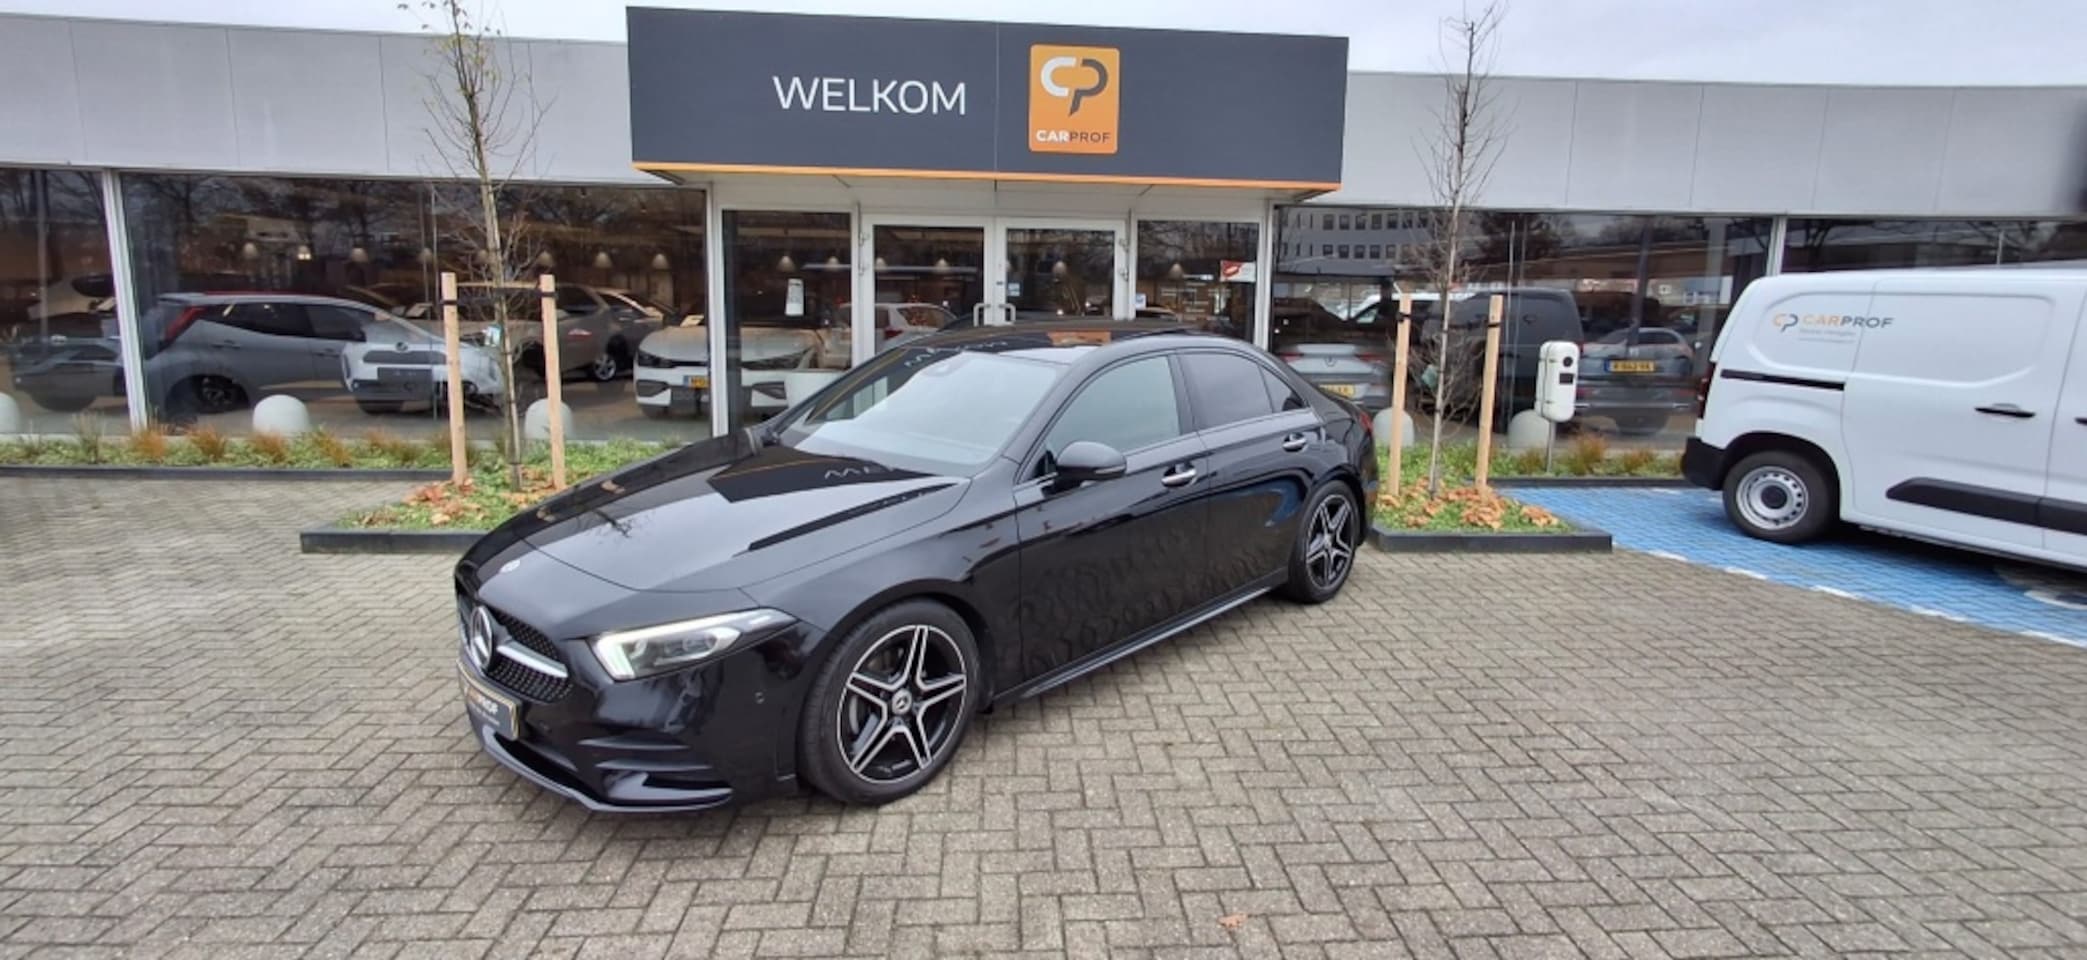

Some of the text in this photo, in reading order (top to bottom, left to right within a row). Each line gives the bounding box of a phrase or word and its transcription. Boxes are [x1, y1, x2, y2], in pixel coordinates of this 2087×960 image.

[773, 75, 967, 116] WELKOM
[1036, 129, 1112, 144] CARPROF
[1802, 313, 1893, 329] CARPROF
